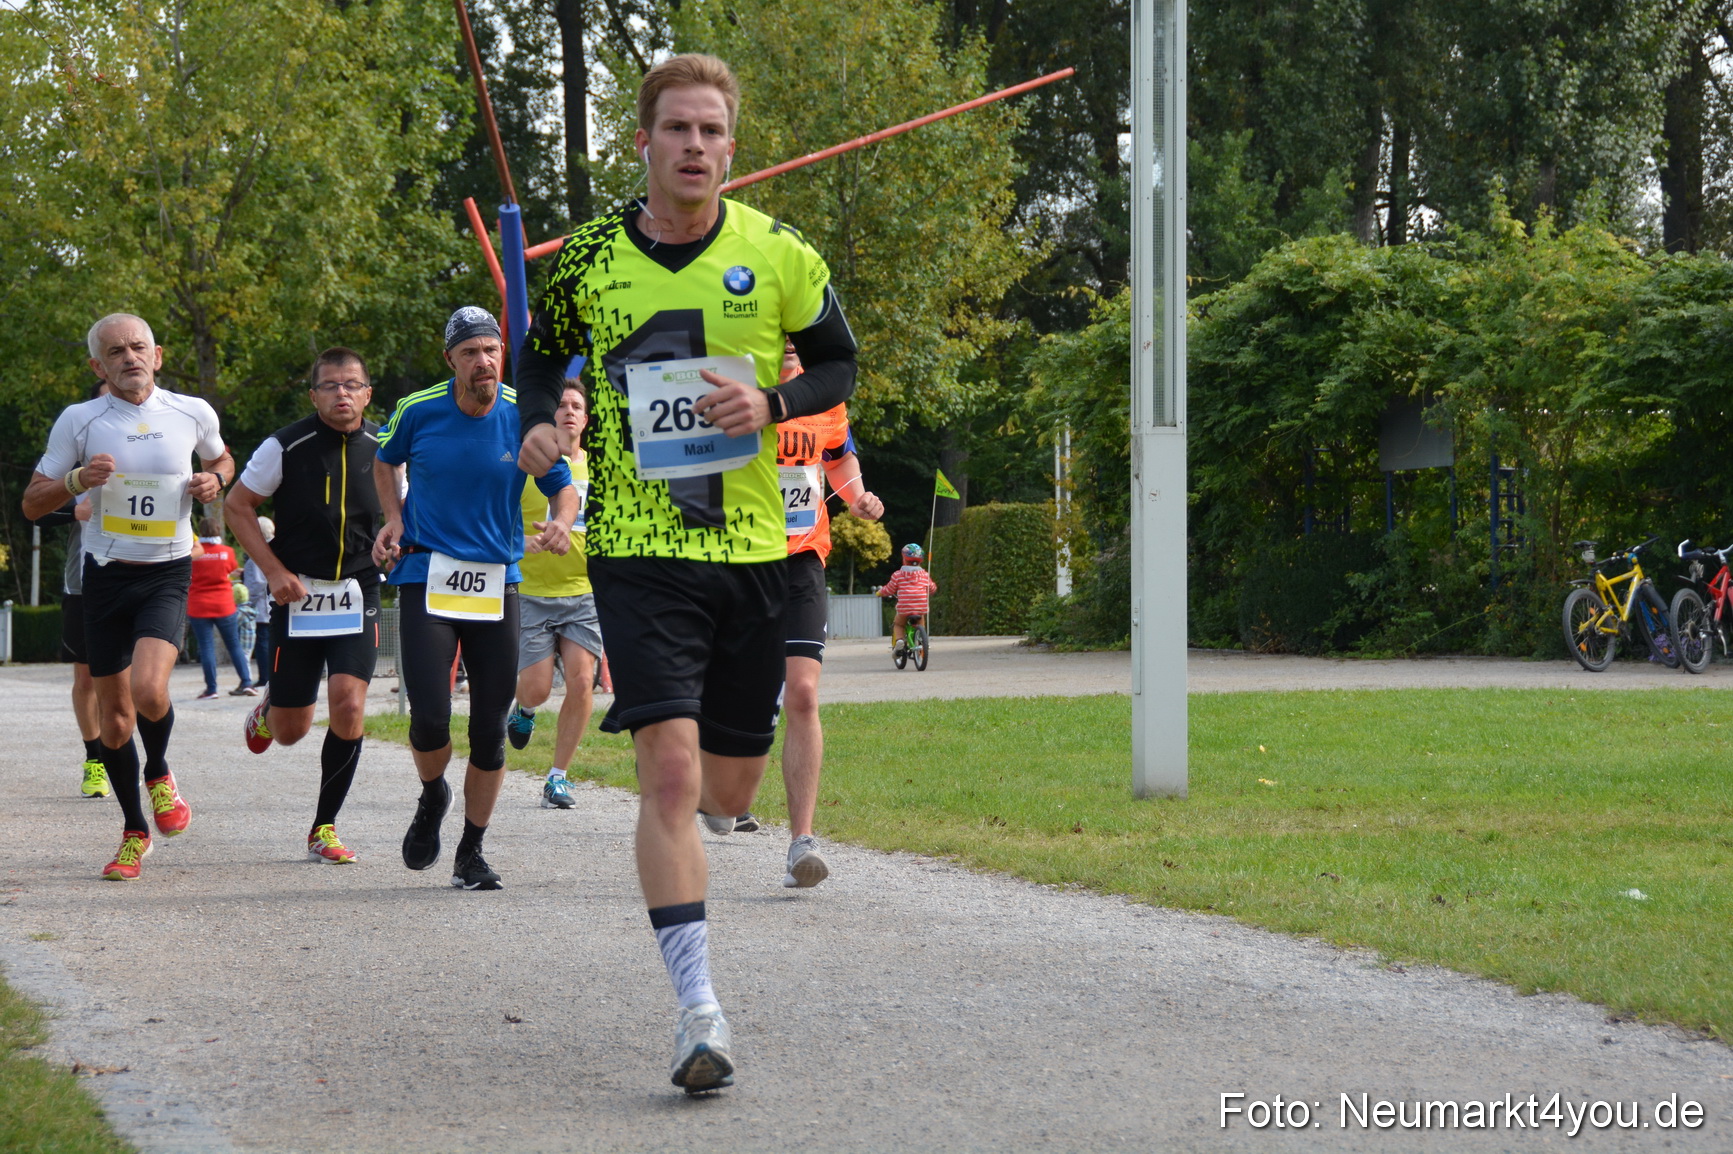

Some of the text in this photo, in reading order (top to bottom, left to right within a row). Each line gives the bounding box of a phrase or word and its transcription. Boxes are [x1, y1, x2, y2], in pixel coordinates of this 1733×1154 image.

[723, 300, 758, 313] Partl
[684, 441, 715, 456] Maxi
[127, 495, 155, 517] 16
[780, 487, 812, 508] 124
[130, 522, 148, 531] Willi
[446, 570, 486, 593] 405
[301, 591, 352, 612] 2714
